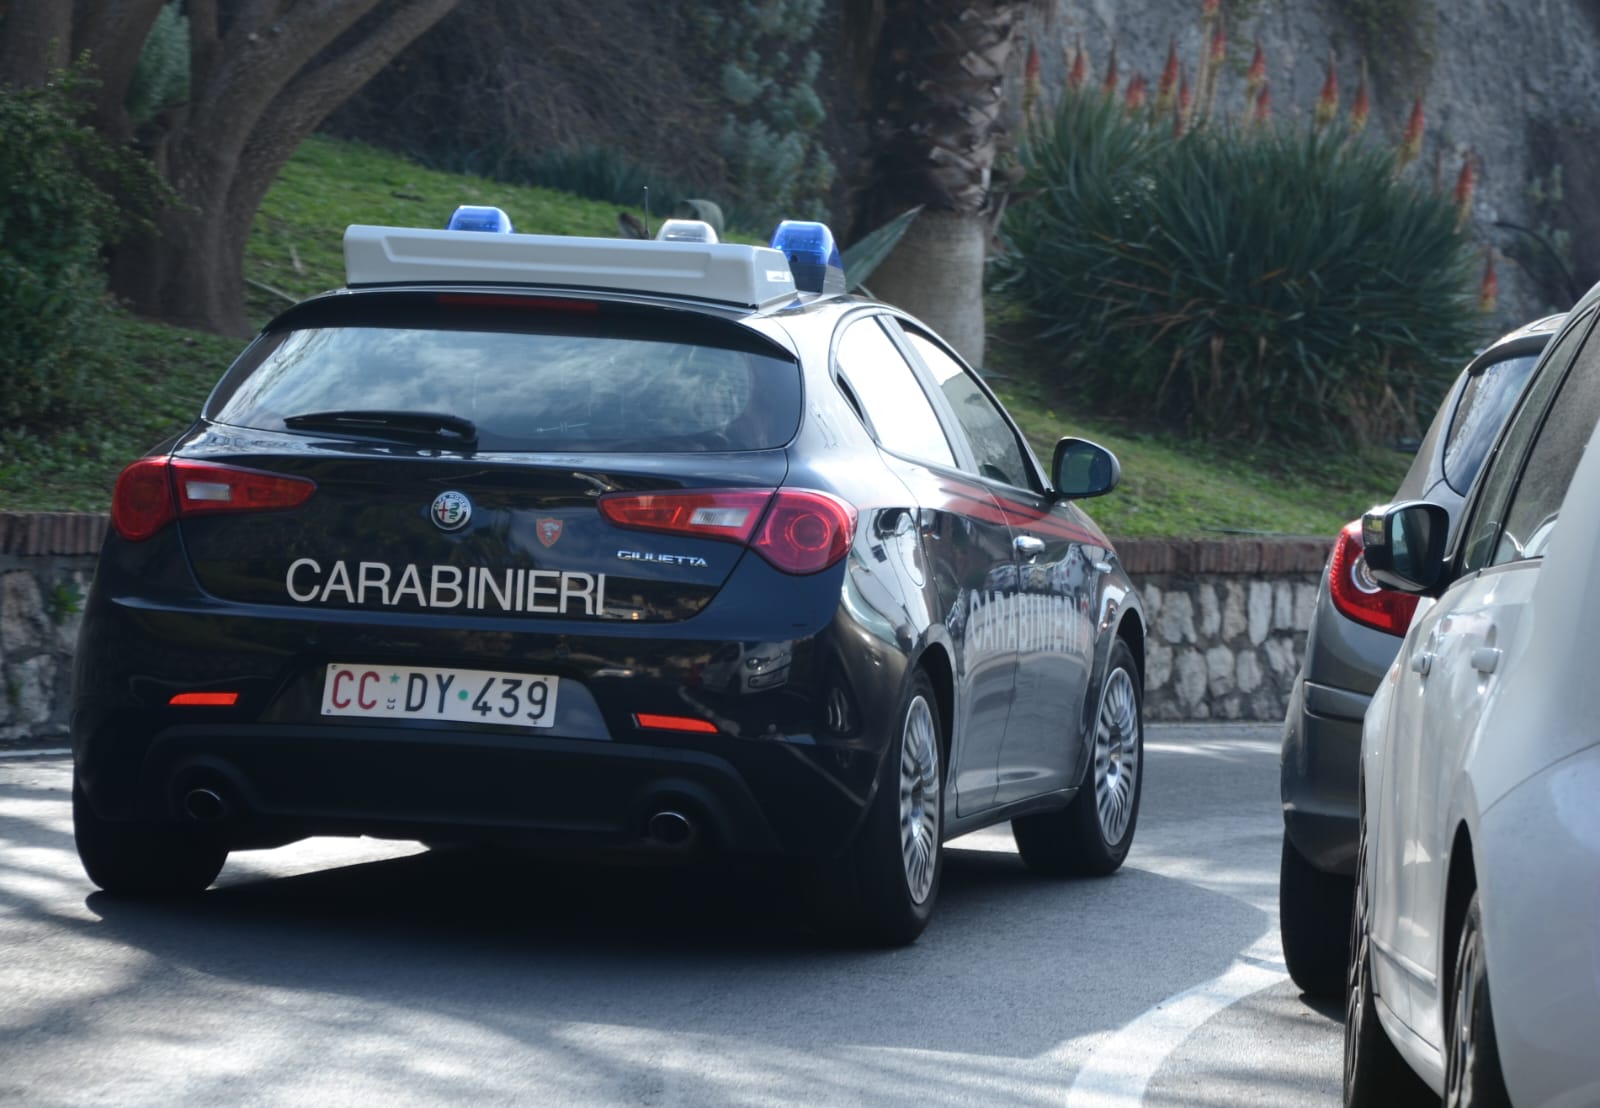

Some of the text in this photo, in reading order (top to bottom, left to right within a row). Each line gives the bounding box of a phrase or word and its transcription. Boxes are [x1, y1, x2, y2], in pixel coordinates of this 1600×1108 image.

[617, 550, 708, 567] GIULIETTA
[286, 558, 605, 616] CARABINIERI
[331, 670, 549, 720] CC DY 439
